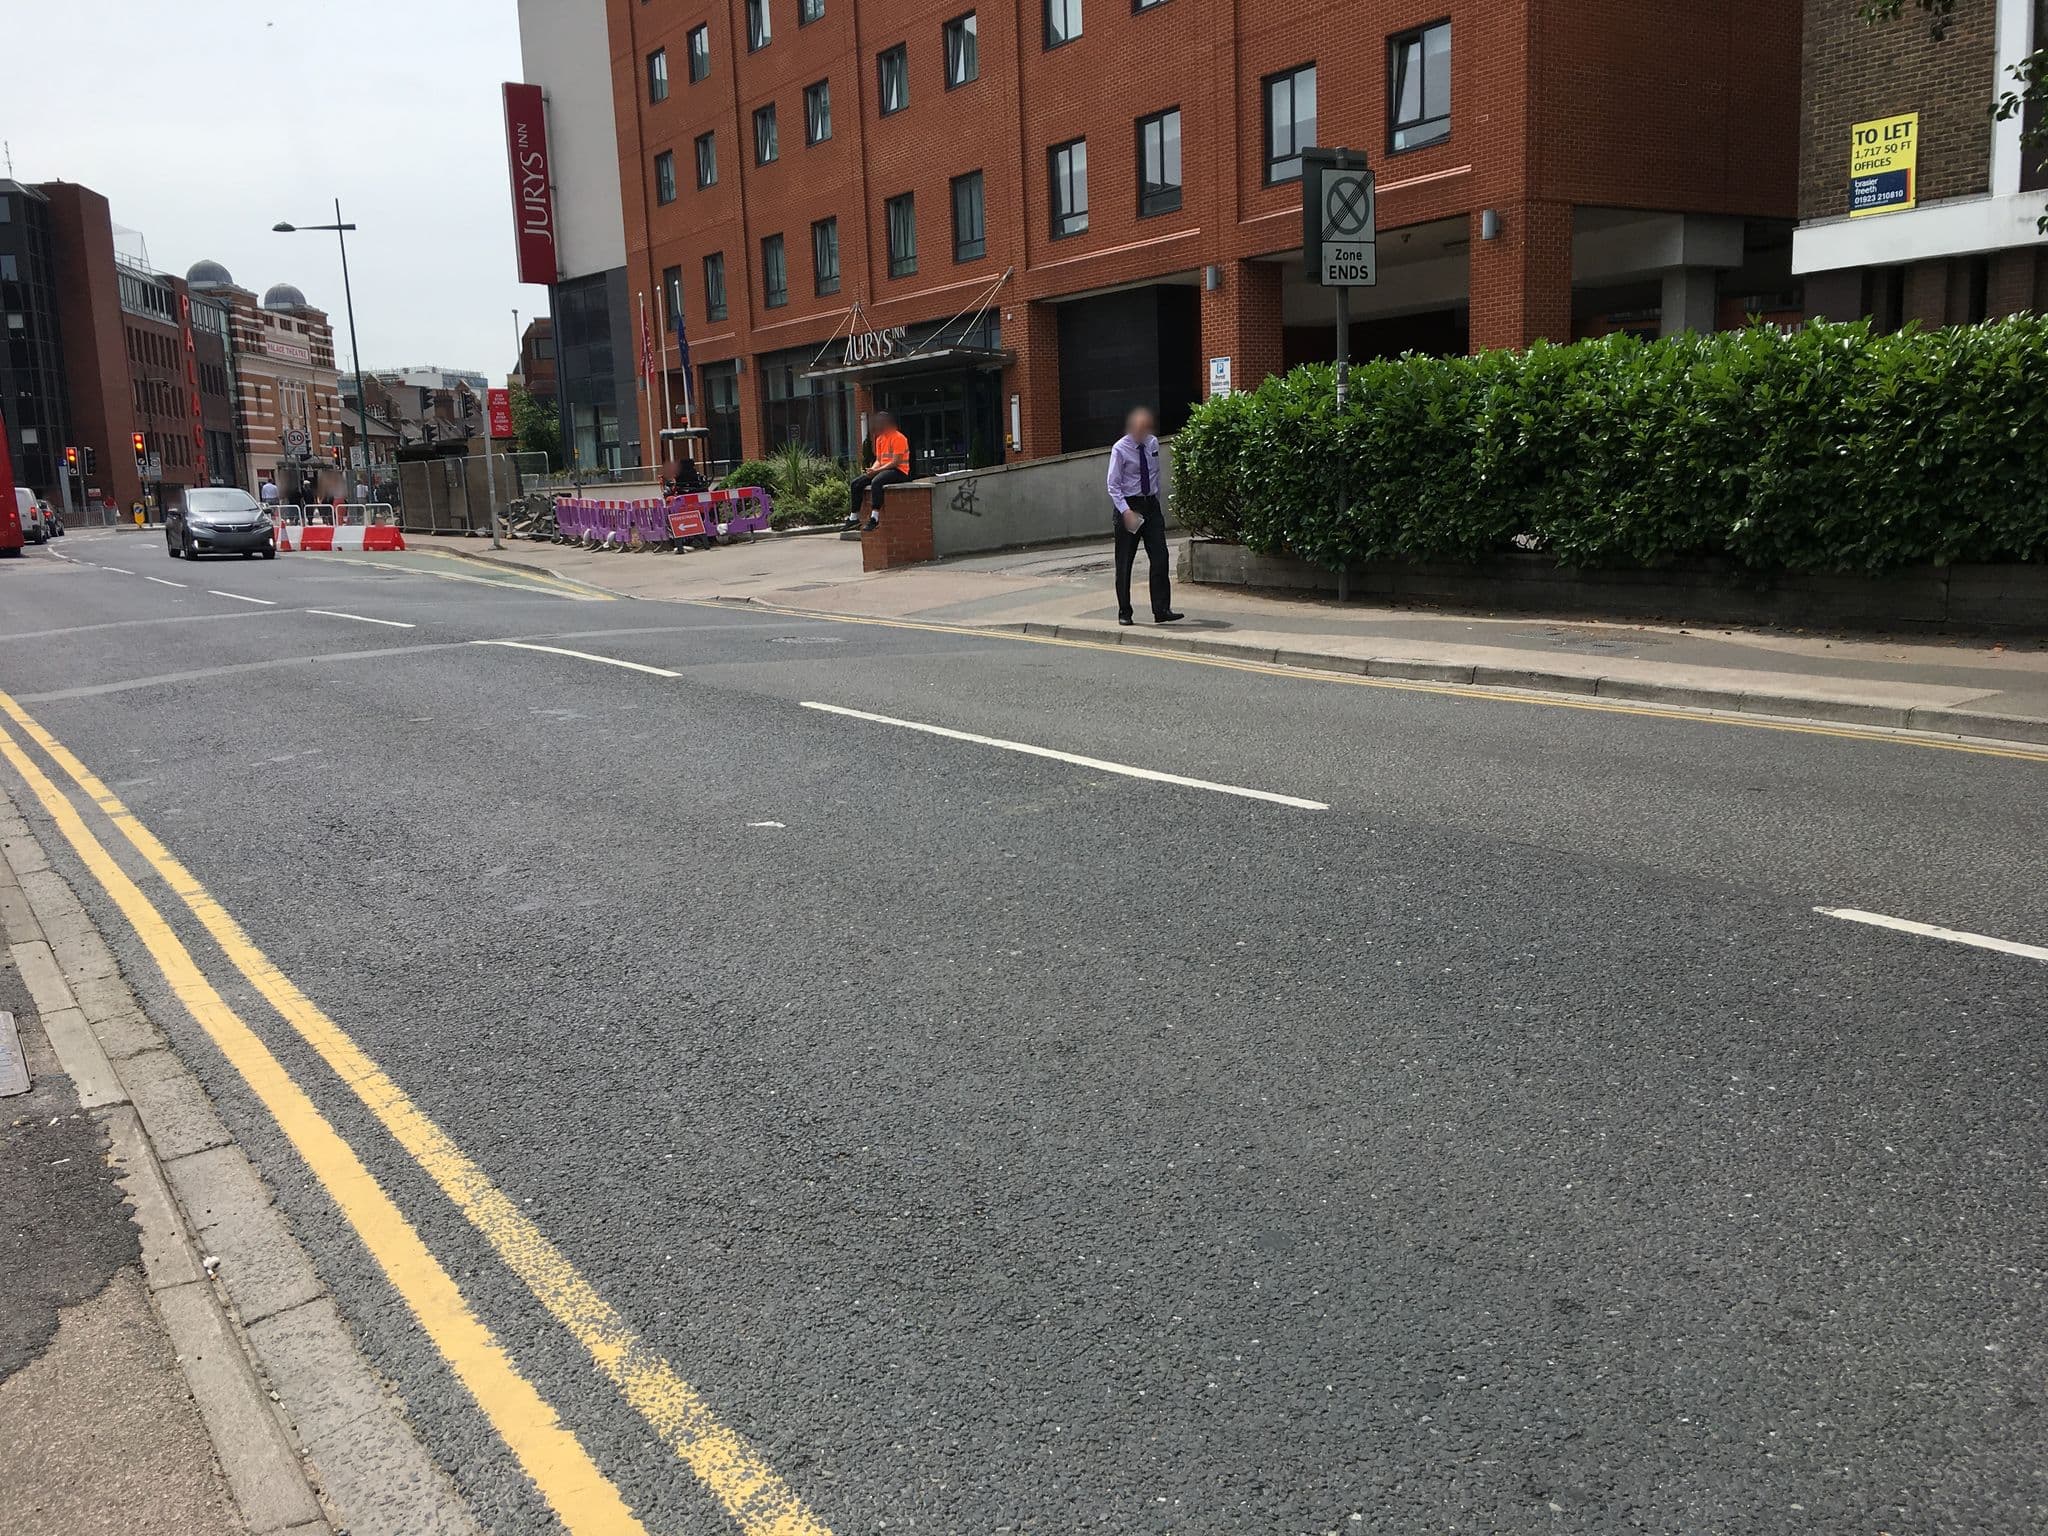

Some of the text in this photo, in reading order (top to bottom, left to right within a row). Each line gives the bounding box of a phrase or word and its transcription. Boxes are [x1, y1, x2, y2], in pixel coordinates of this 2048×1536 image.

[1855, 121, 1912, 145] TO LET
[1855, 140, 1912, 160] 1,717 SQ FT
[1854, 157, 1892, 171] OFFICES
[516, 122, 552, 245] JURYS INN
[1854, 194, 1876, 204] 01923
[1335, 248, 1362, 261] Zone
[1329, 265, 1369, 280] ENDS
[286, 346, 308, 359] THEATRE
[845, 325, 906, 366] JURYS INN
